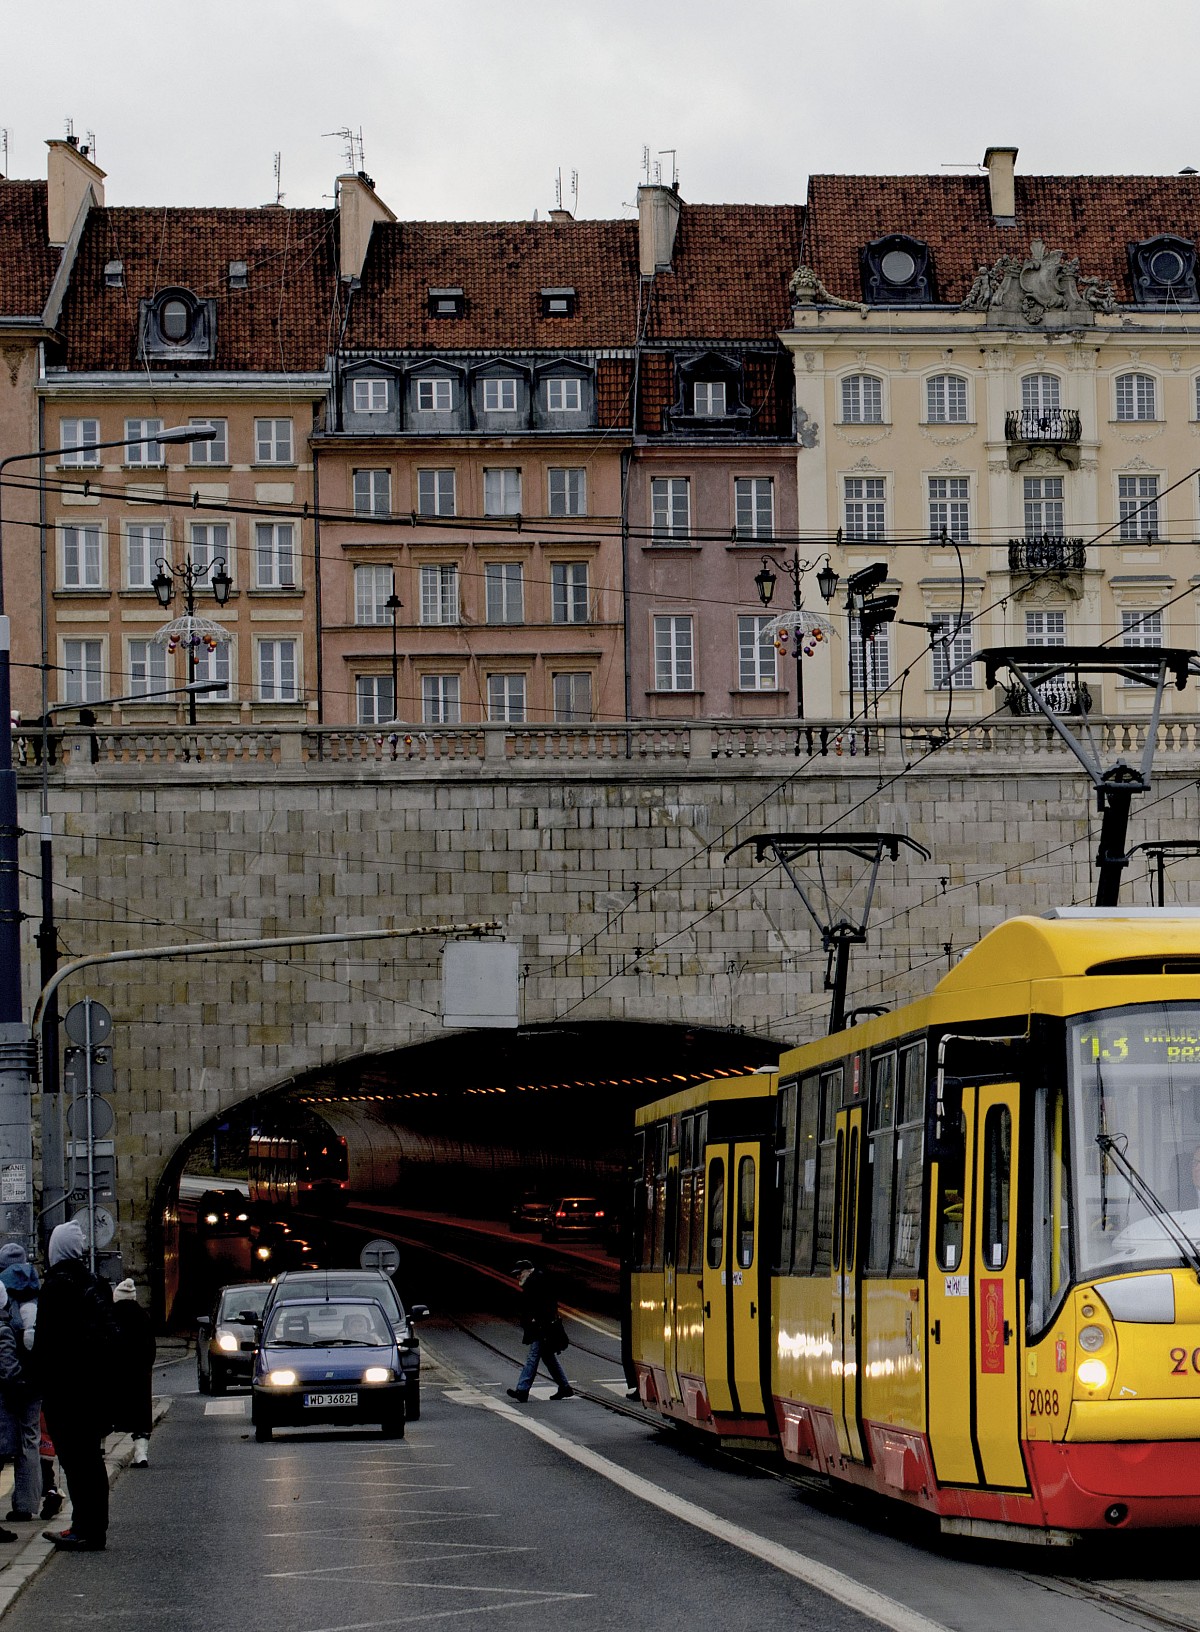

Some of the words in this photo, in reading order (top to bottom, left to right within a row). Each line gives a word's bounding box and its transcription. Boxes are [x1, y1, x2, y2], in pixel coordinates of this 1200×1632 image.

[310, 1395, 324, 1405] WD
[327, 1394, 357, 1404] 3682E
[1029, 1389, 1059, 1416] 2088
